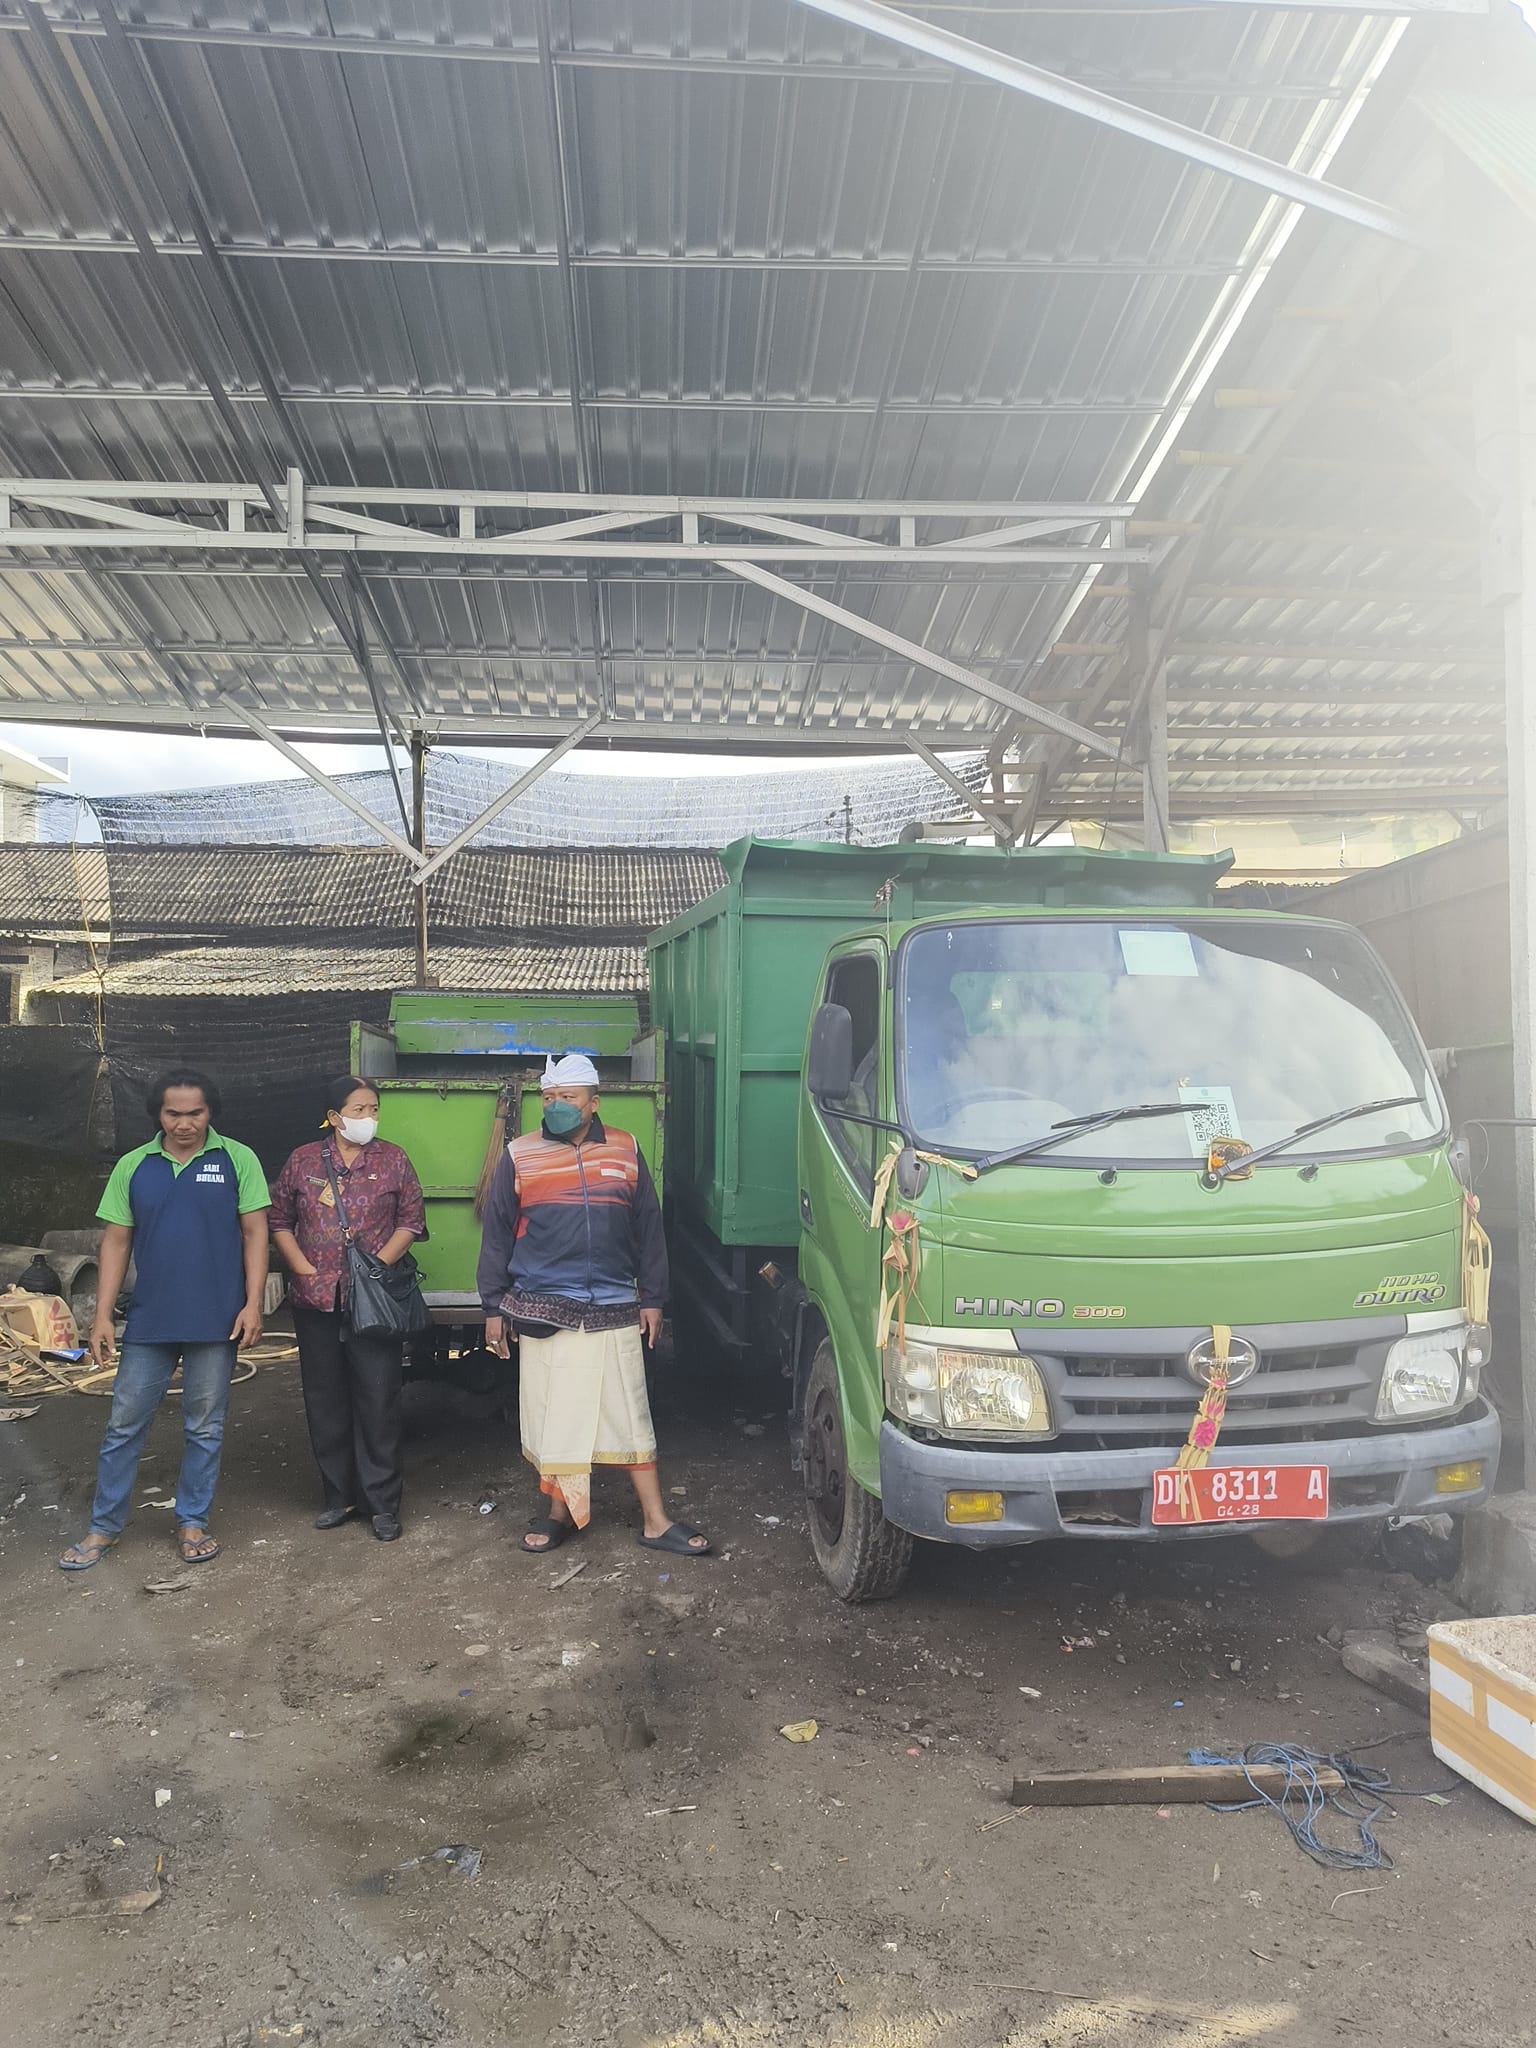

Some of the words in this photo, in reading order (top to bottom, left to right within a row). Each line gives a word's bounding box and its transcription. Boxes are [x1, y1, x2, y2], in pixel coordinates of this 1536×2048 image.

[203, 1164, 220, 1172] SARI
[1380, 1275, 1411, 1288] 110
[1411, 1272, 1439, 1285] HD
[1353, 1285, 1446, 1306] DUTRO
[955, 1296, 1065, 1318] HINO
[1073, 1305, 1126, 1319] 300
[1211, 1470, 1278, 1503] 8311
[1307, 1469, 1324, 1500] A
